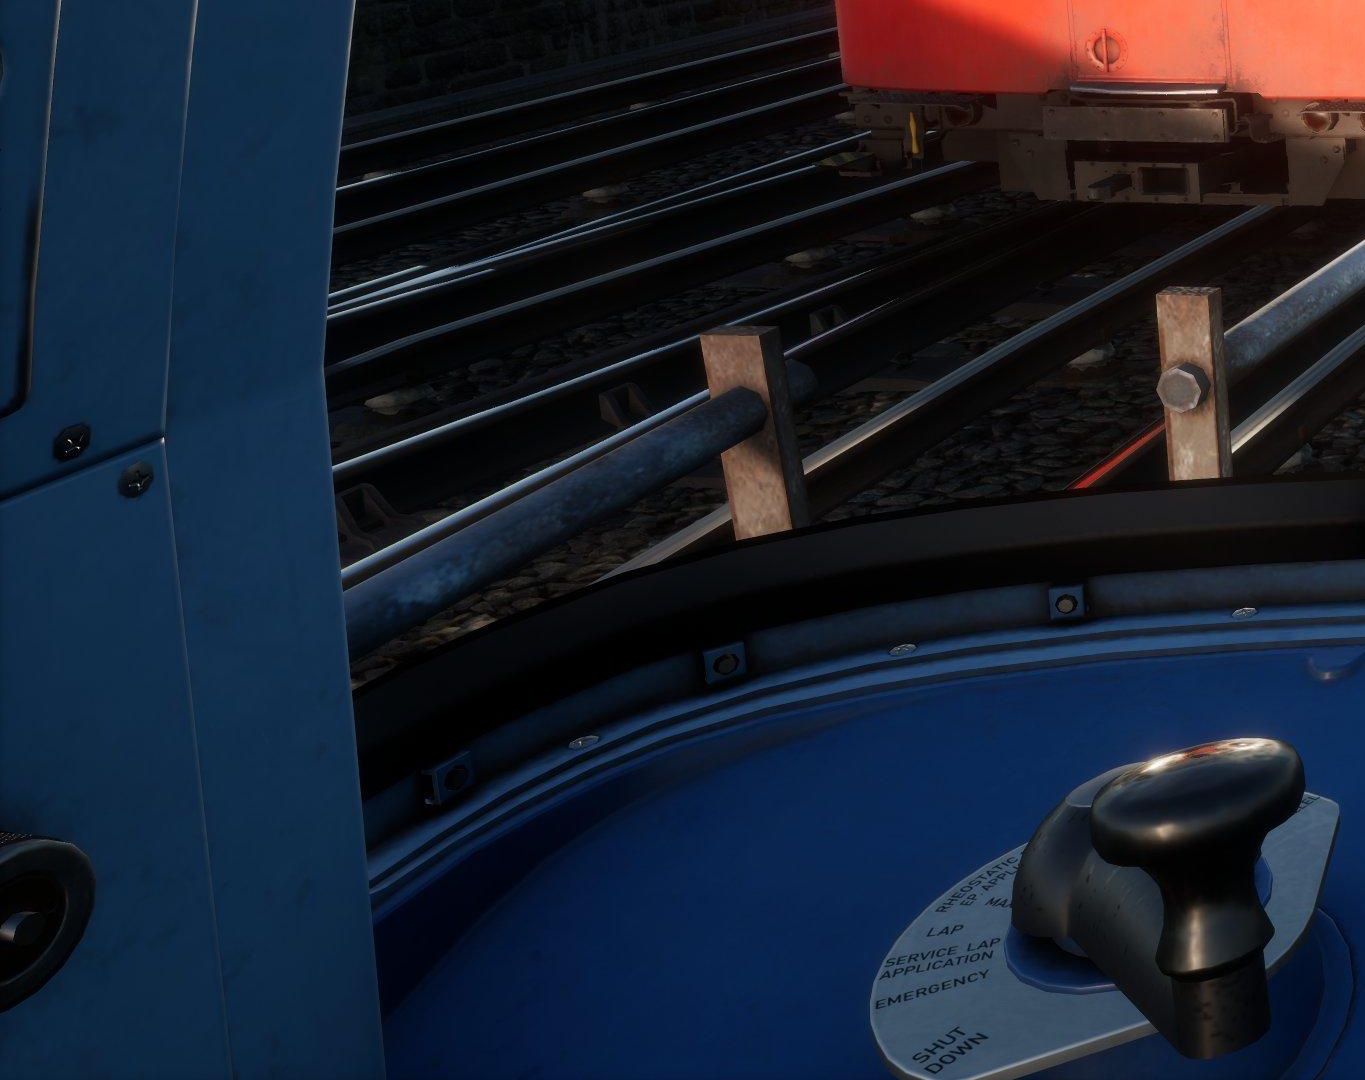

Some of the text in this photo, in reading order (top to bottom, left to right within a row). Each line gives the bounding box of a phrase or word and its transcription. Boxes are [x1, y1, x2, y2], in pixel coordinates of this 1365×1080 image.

[936, 857, 1018, 913] RHEOSTATIC
[926, 924, 964, 938] LAP
[879, 950, 994, 981] APPLICATION
[884, 938, 1001, 968] SERVICE LAP
[875, 969, 989, 1010] EMERGENCY
[912, 1026, 966, 1063] SHUT
[924, 1032, 989, 1074] DOWN
